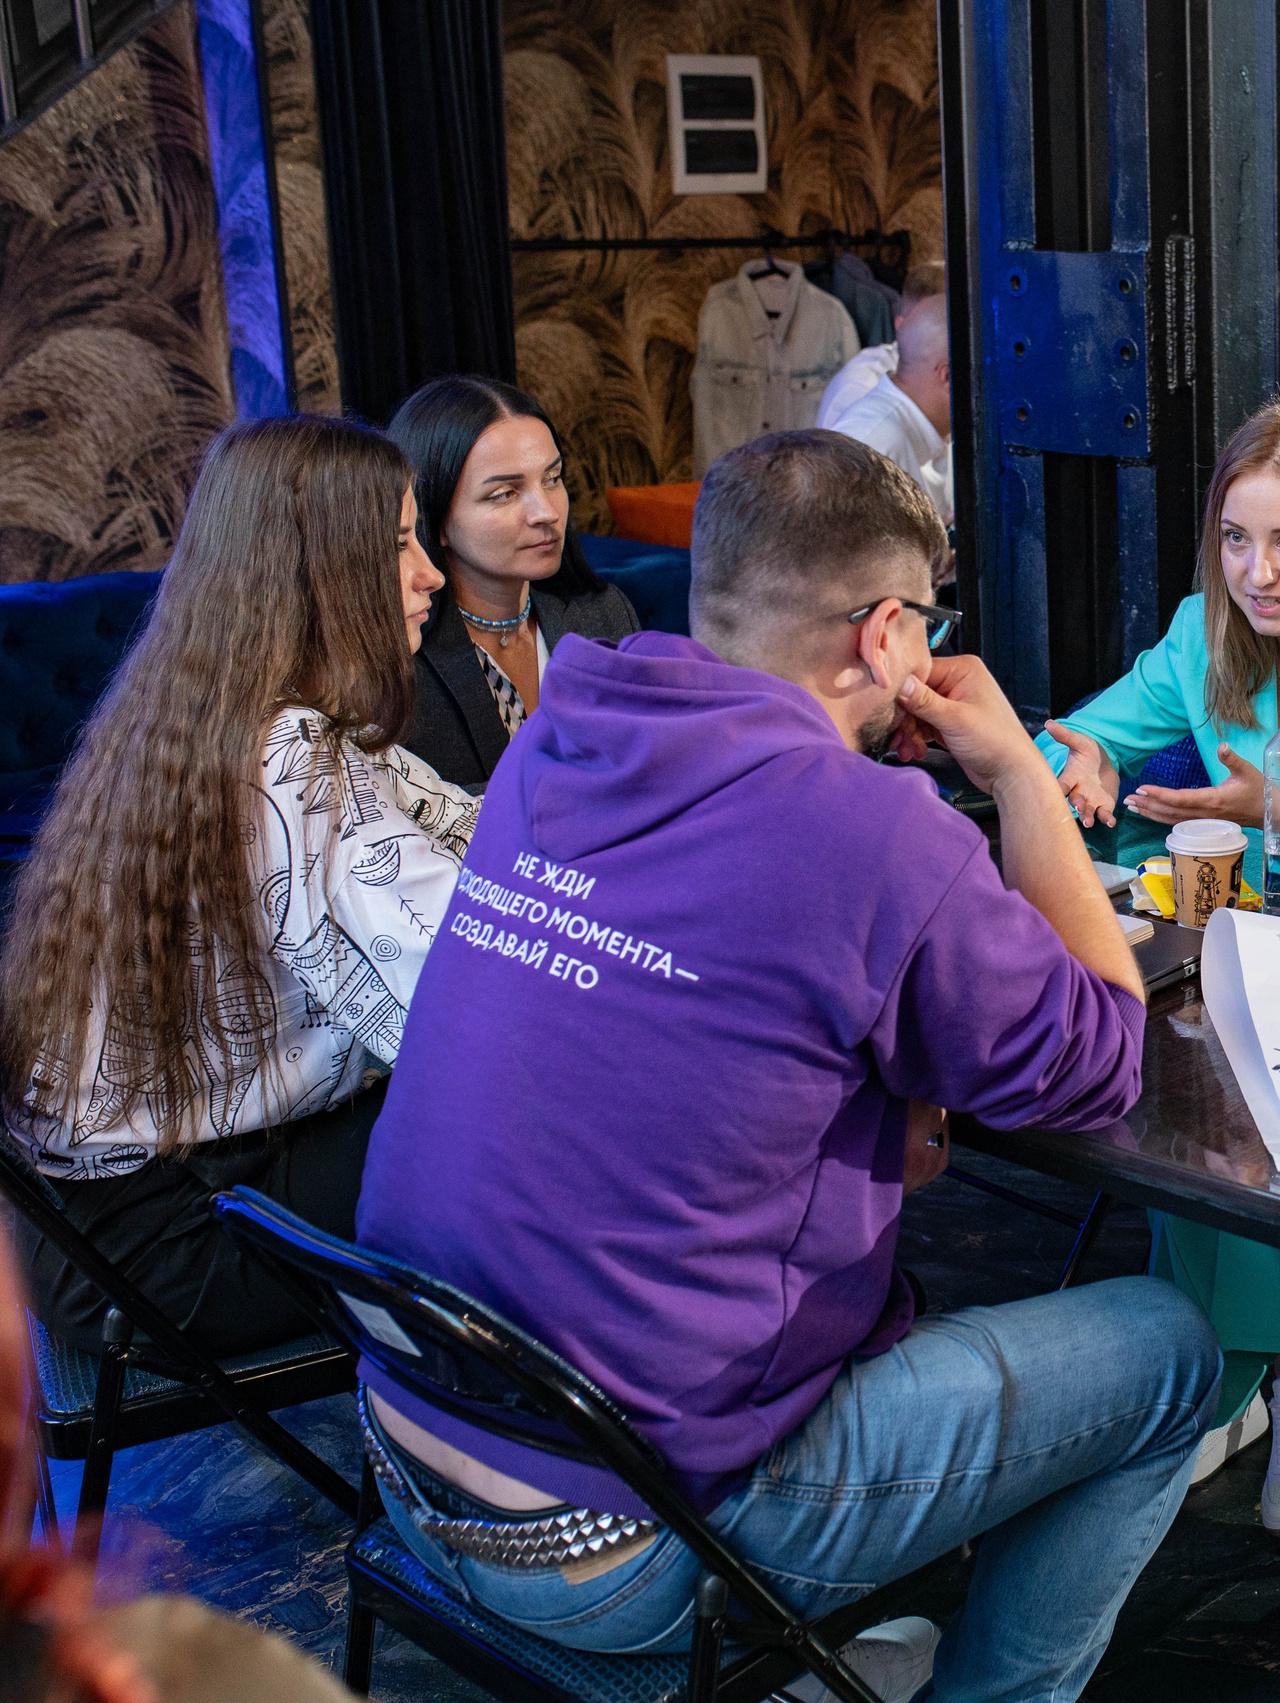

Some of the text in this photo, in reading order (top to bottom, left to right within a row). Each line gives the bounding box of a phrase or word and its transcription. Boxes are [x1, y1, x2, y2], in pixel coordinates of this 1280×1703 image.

[512, 851, 596, 900] НЕ ЖДИ
[451, 912, 599, 990] СОЗДАВАЙ ЕГО
